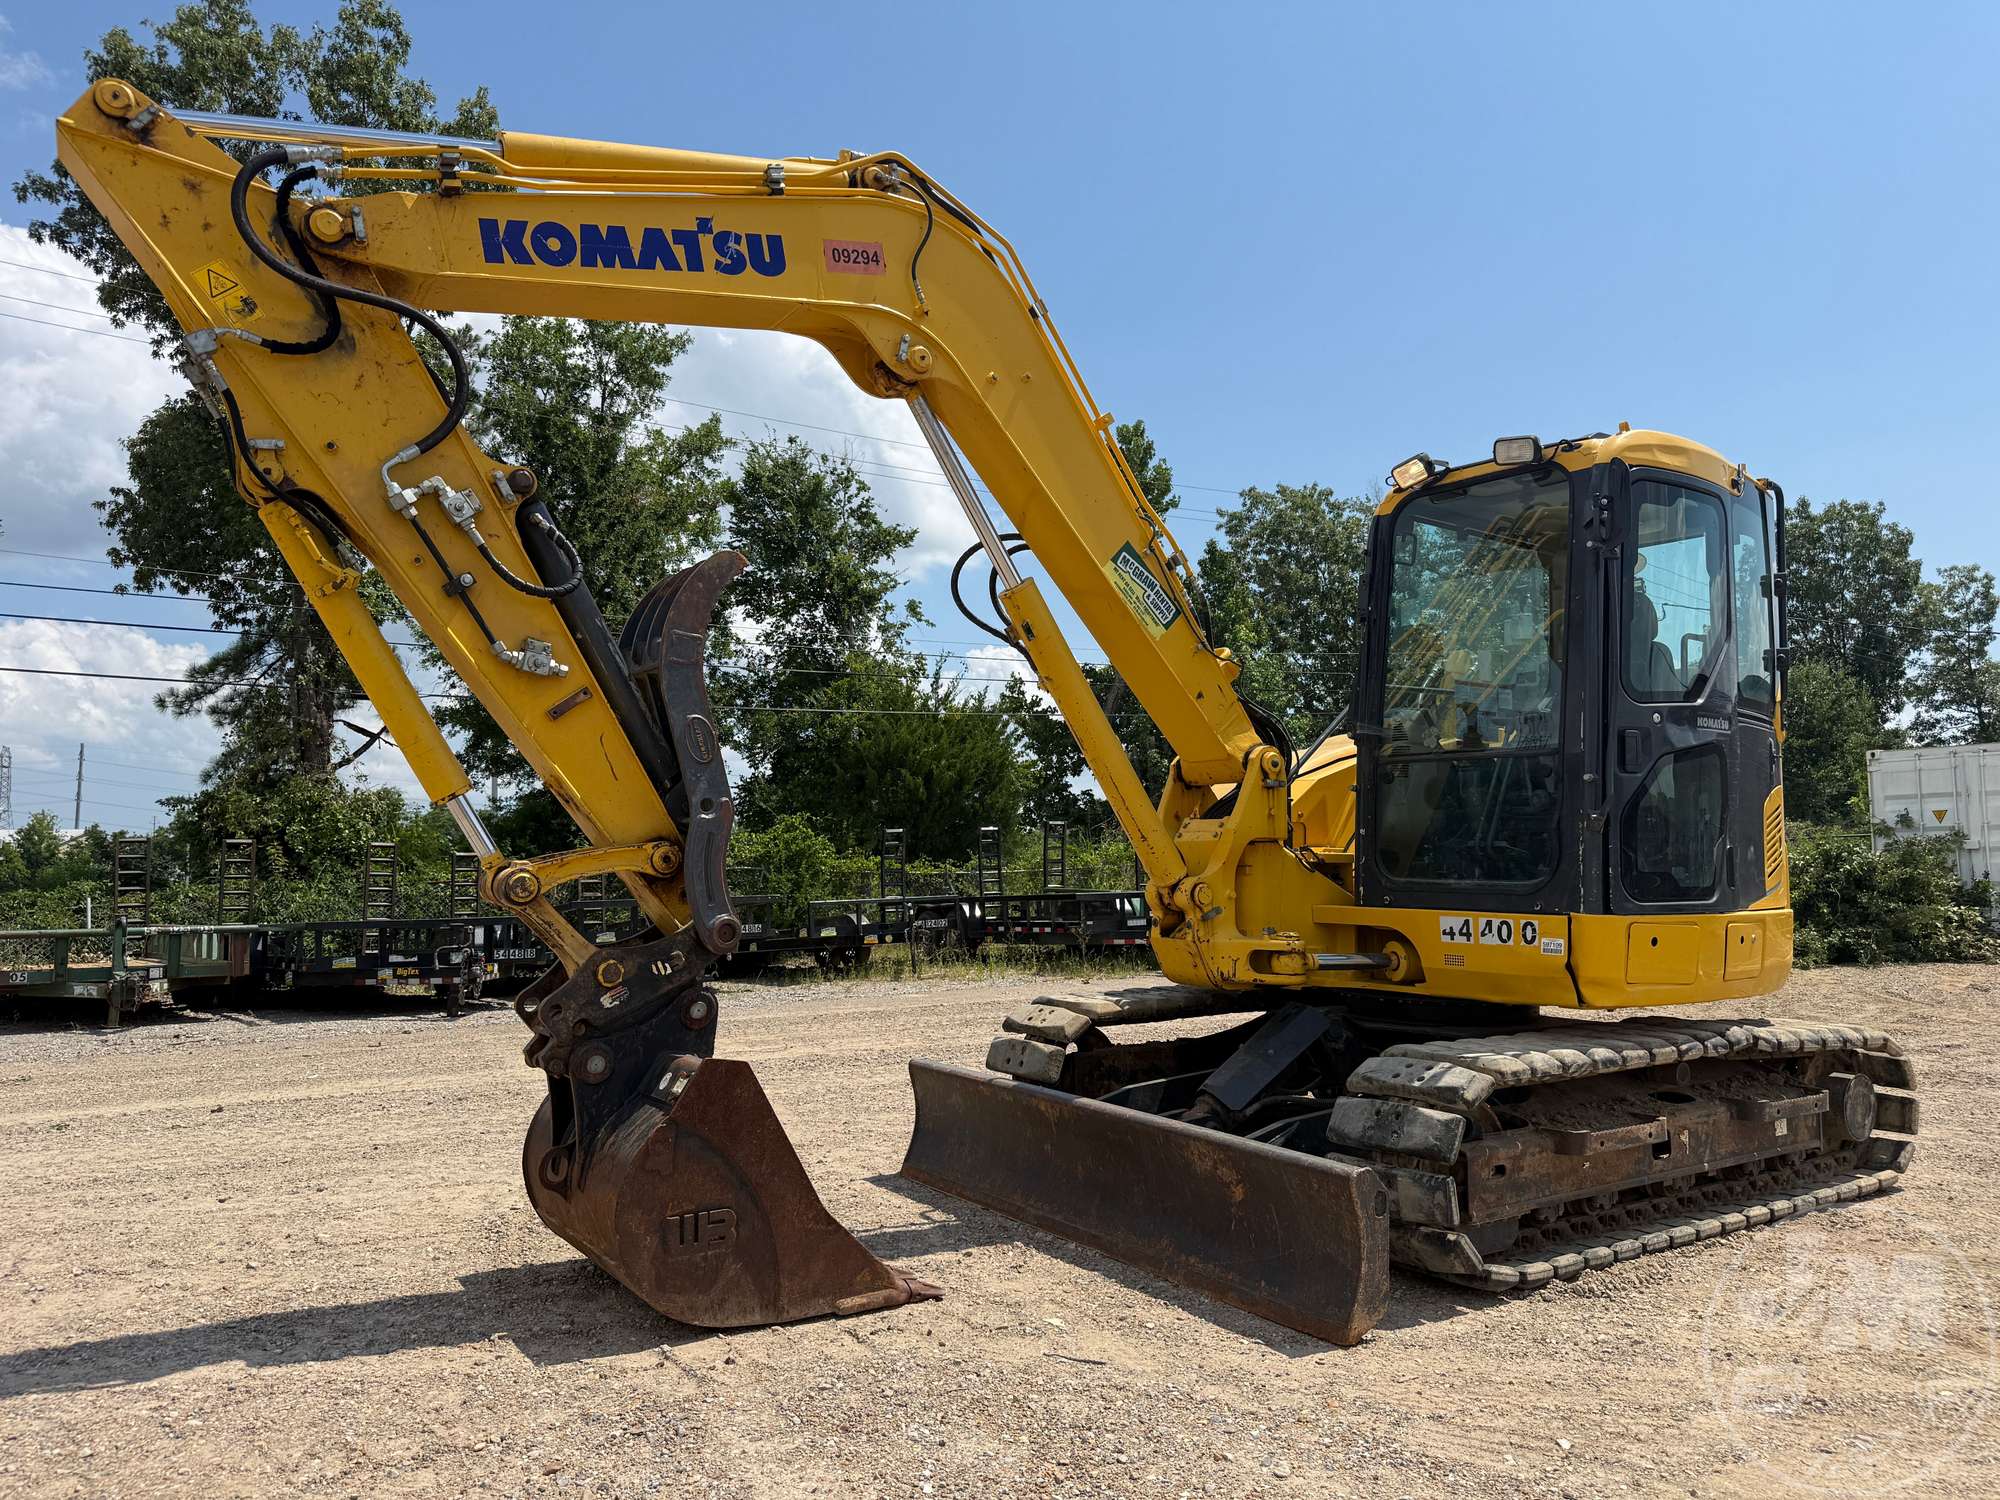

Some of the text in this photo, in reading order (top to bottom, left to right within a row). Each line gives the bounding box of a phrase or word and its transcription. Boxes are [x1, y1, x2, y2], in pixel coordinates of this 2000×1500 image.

[478, 216, 787, 278] KOMATSU
[832, 249, 881, 267] 09294
[1149, 598, 1170, 622] SUPPLY
[1153, 589, 1175, 616] RENTAL
[1697, 716, 1729, 730] KOMATSU
